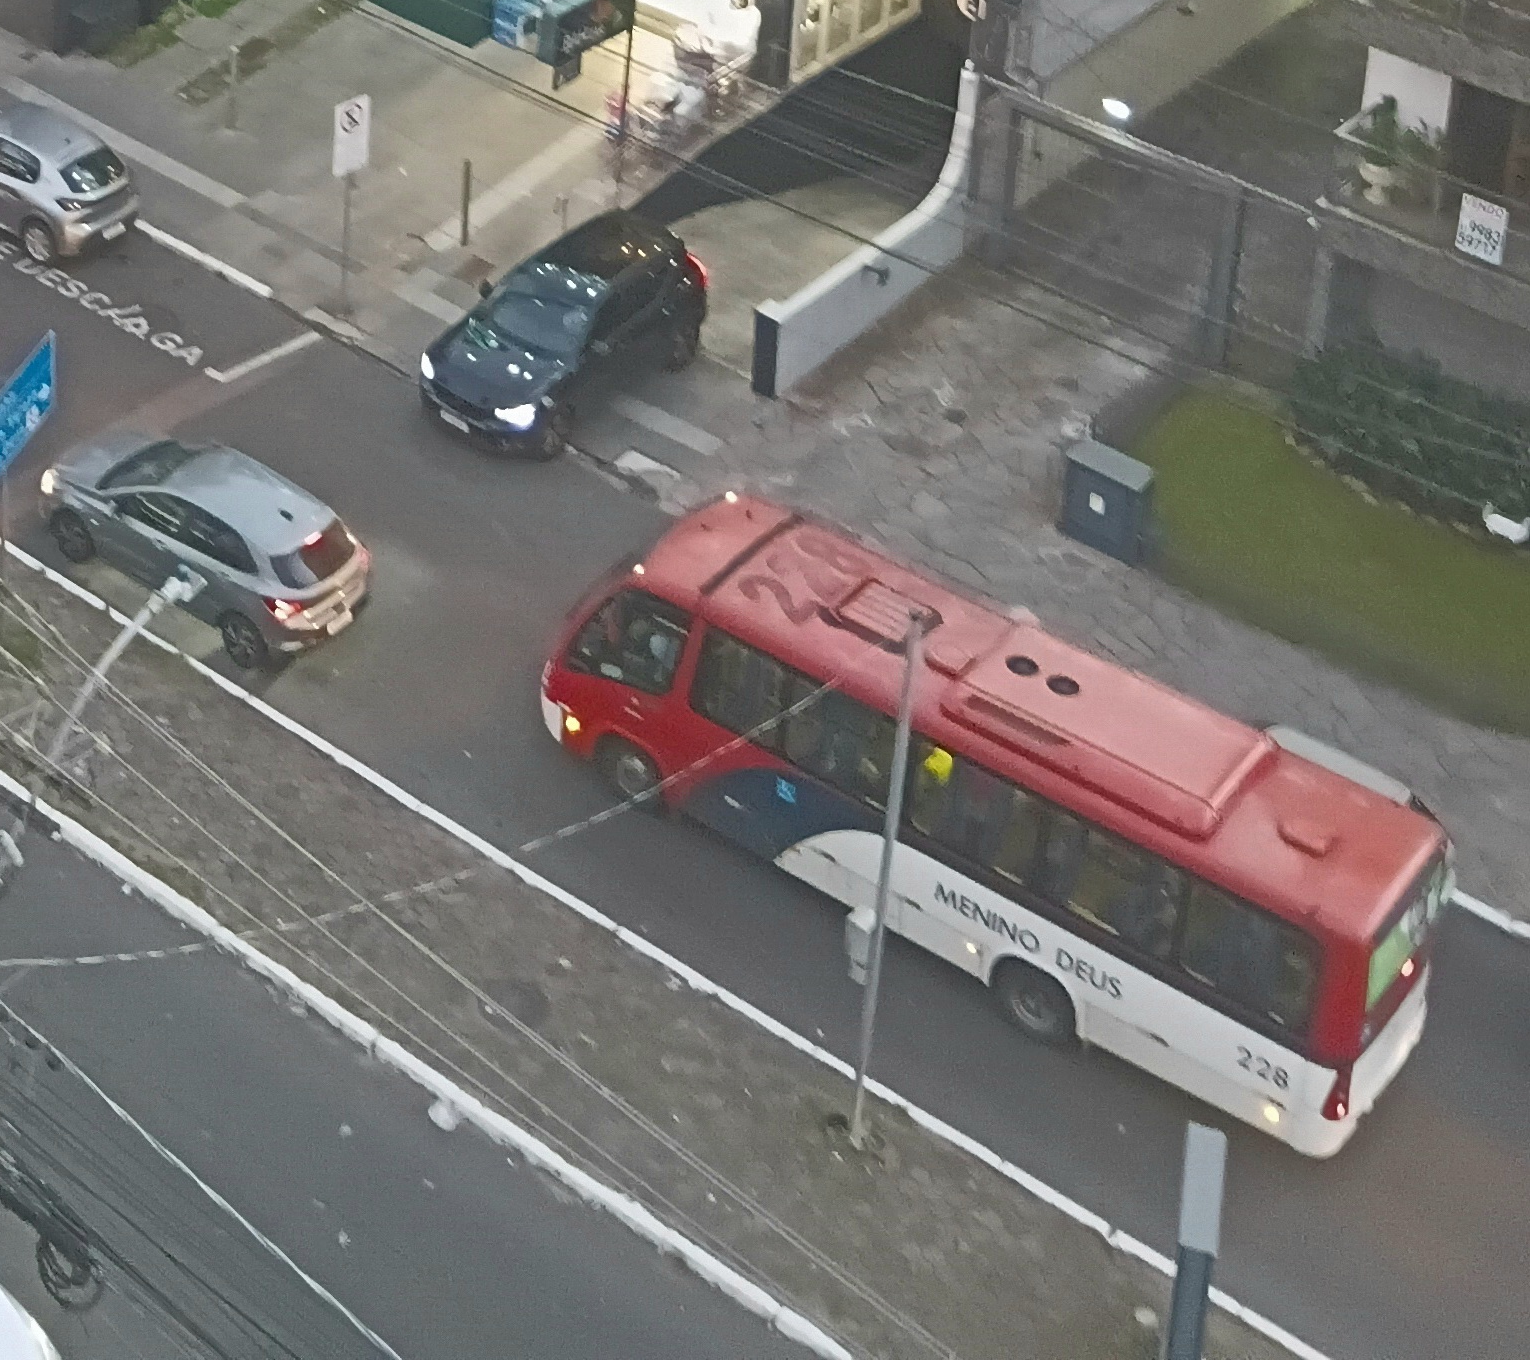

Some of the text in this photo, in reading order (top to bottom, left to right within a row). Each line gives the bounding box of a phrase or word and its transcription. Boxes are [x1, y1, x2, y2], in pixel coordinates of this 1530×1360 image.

[934, 881, 1123, 1000] MENINO DEUS
[1235, 1044, 1290, 1091] 228
